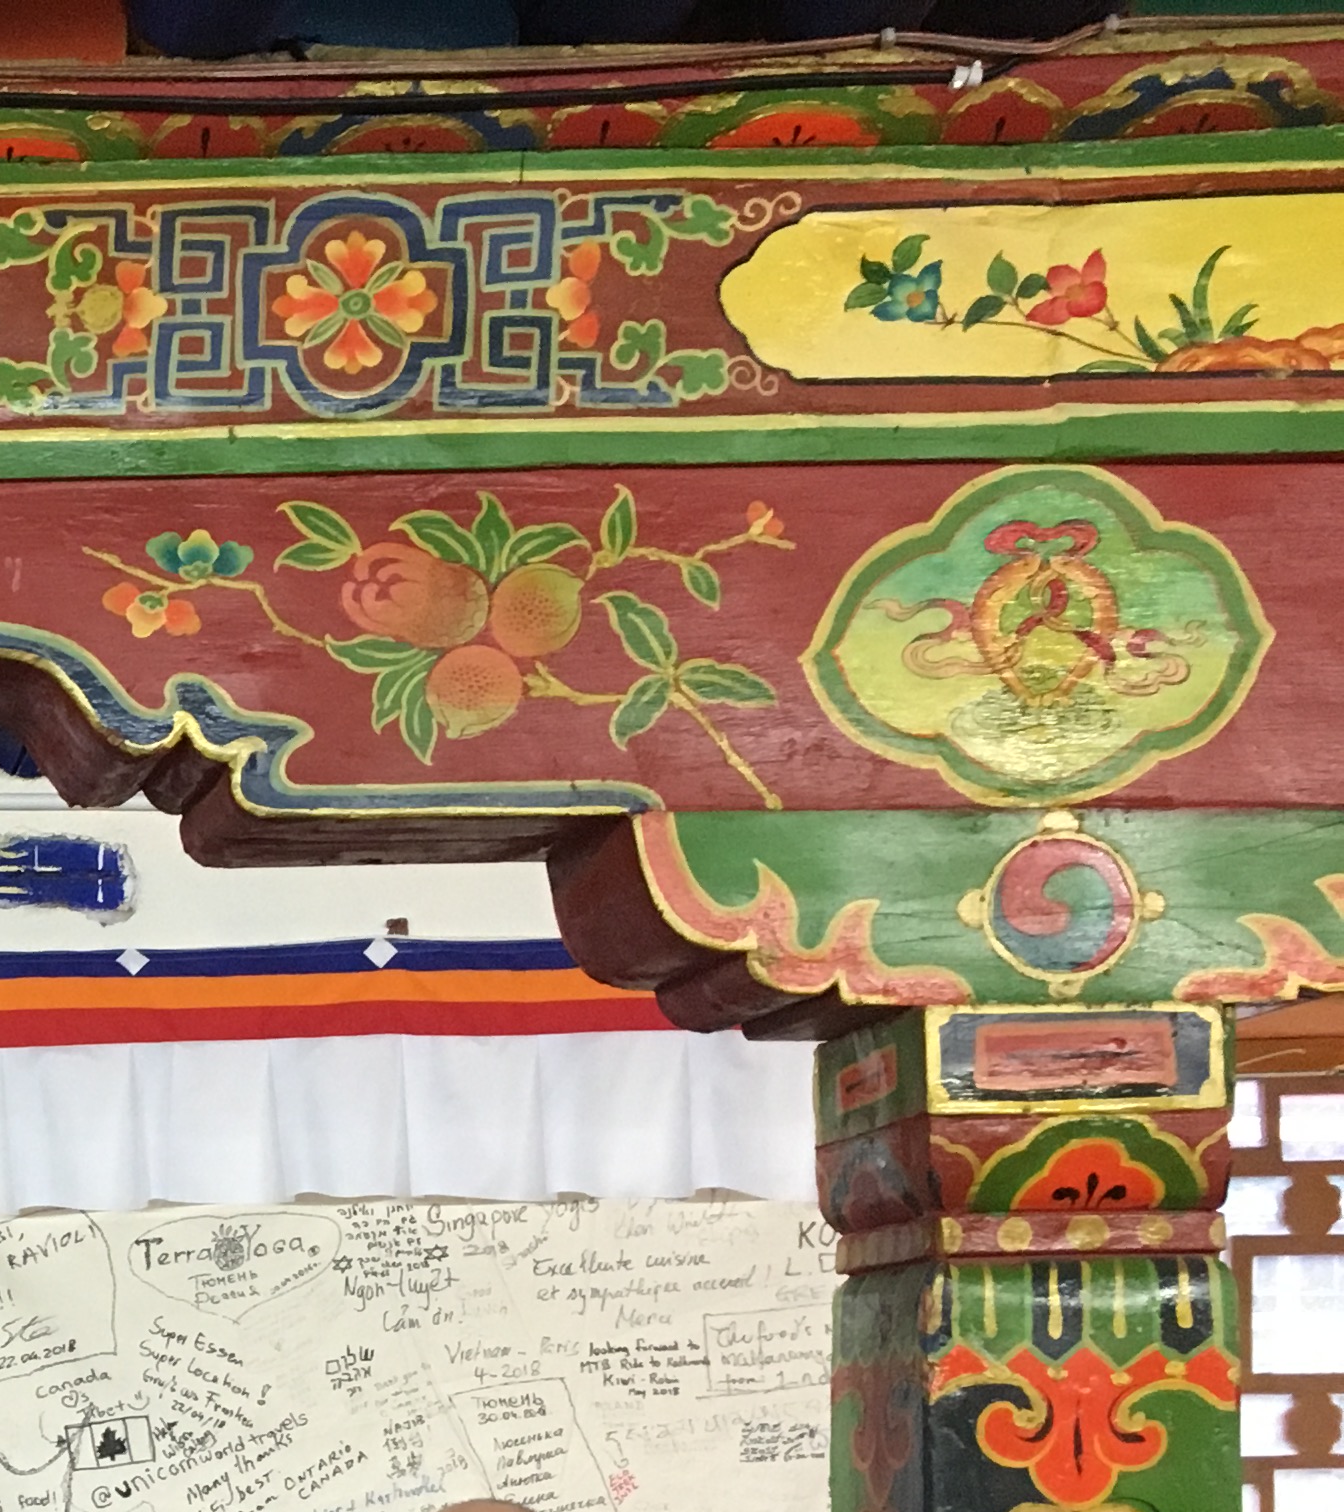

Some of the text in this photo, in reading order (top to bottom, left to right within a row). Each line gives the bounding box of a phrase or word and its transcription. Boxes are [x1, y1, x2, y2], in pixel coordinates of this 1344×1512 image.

[422, 1203, 528, 1242] Singapore
[8, 1224, 97, 1269] RAVIOLI
[134, 1237, 213, 1271] Terra
[537, 1286, 560, 1301] et
[139, 1339, 181, 1372] Super
[149, 1315, 244, 1367] Super Essen
[687, 1339, 700, 1350] to
[580, 1359, 611, 1373] MTB
[649, 1357, 661, 1368] to
[187, 1472, 234, 1507] Many
[298, 1451, 368, 1500] CANADA
